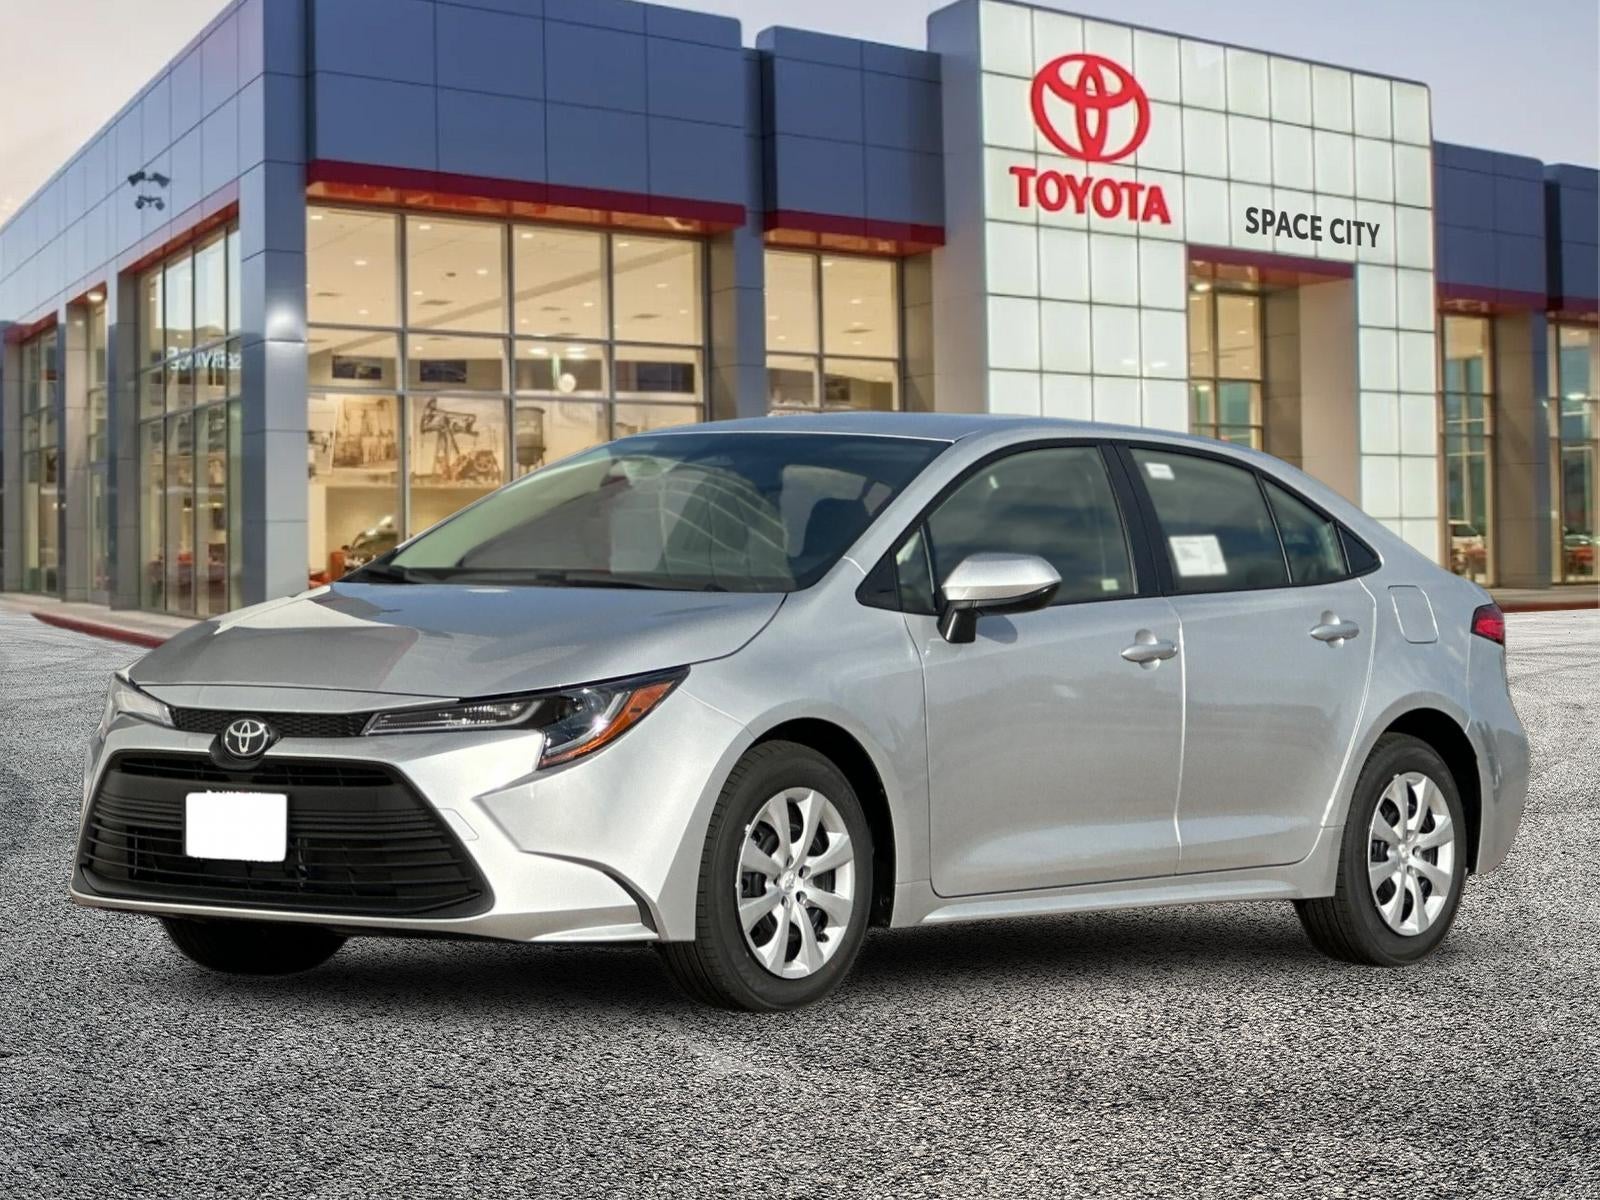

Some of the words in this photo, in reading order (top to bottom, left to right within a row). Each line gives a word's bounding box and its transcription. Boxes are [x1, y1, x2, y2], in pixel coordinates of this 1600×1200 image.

[1009, 166, 1171, 224] TOYOTA
[1245, 206, 1323, 242] SPACE
[1329, 217, 1381, 248] CITY
